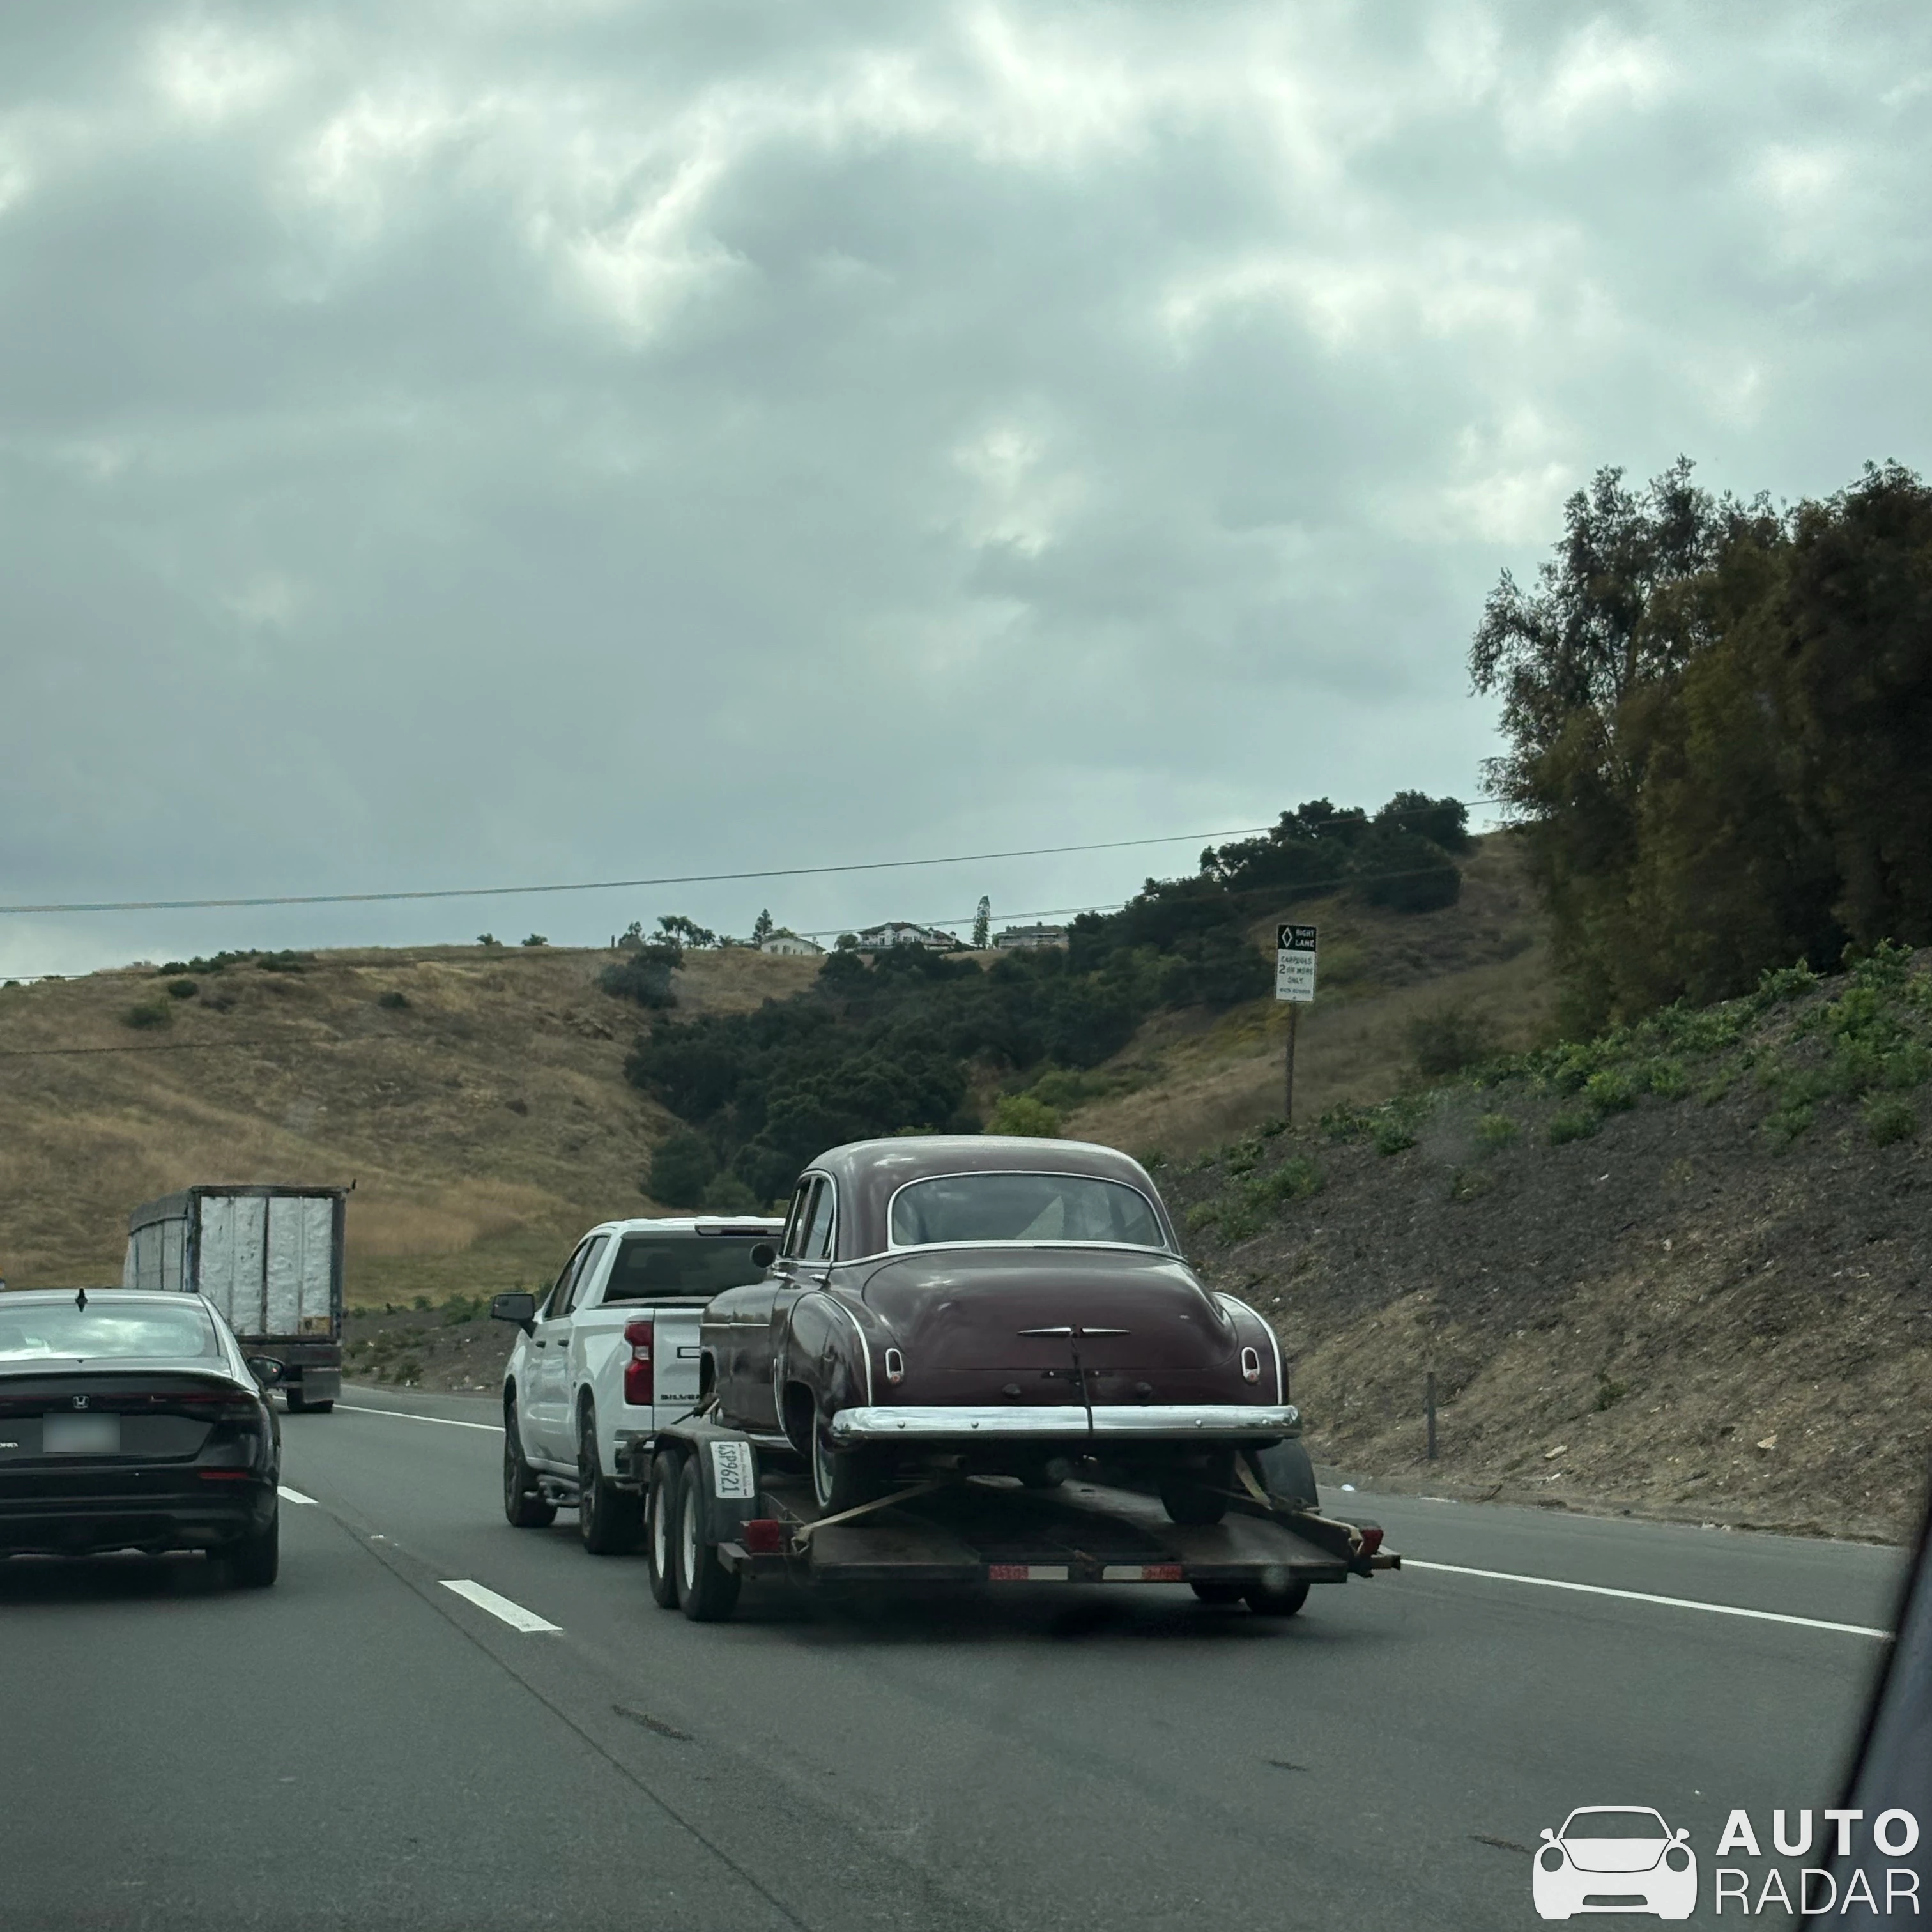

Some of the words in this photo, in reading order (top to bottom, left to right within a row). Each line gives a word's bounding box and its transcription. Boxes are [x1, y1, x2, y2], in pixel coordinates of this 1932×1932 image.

[1295, 939, 1314, 947] LANE
[1279, 964, 1285, 974] 2
[717, 1445, 740, 1493] 4SP9621
